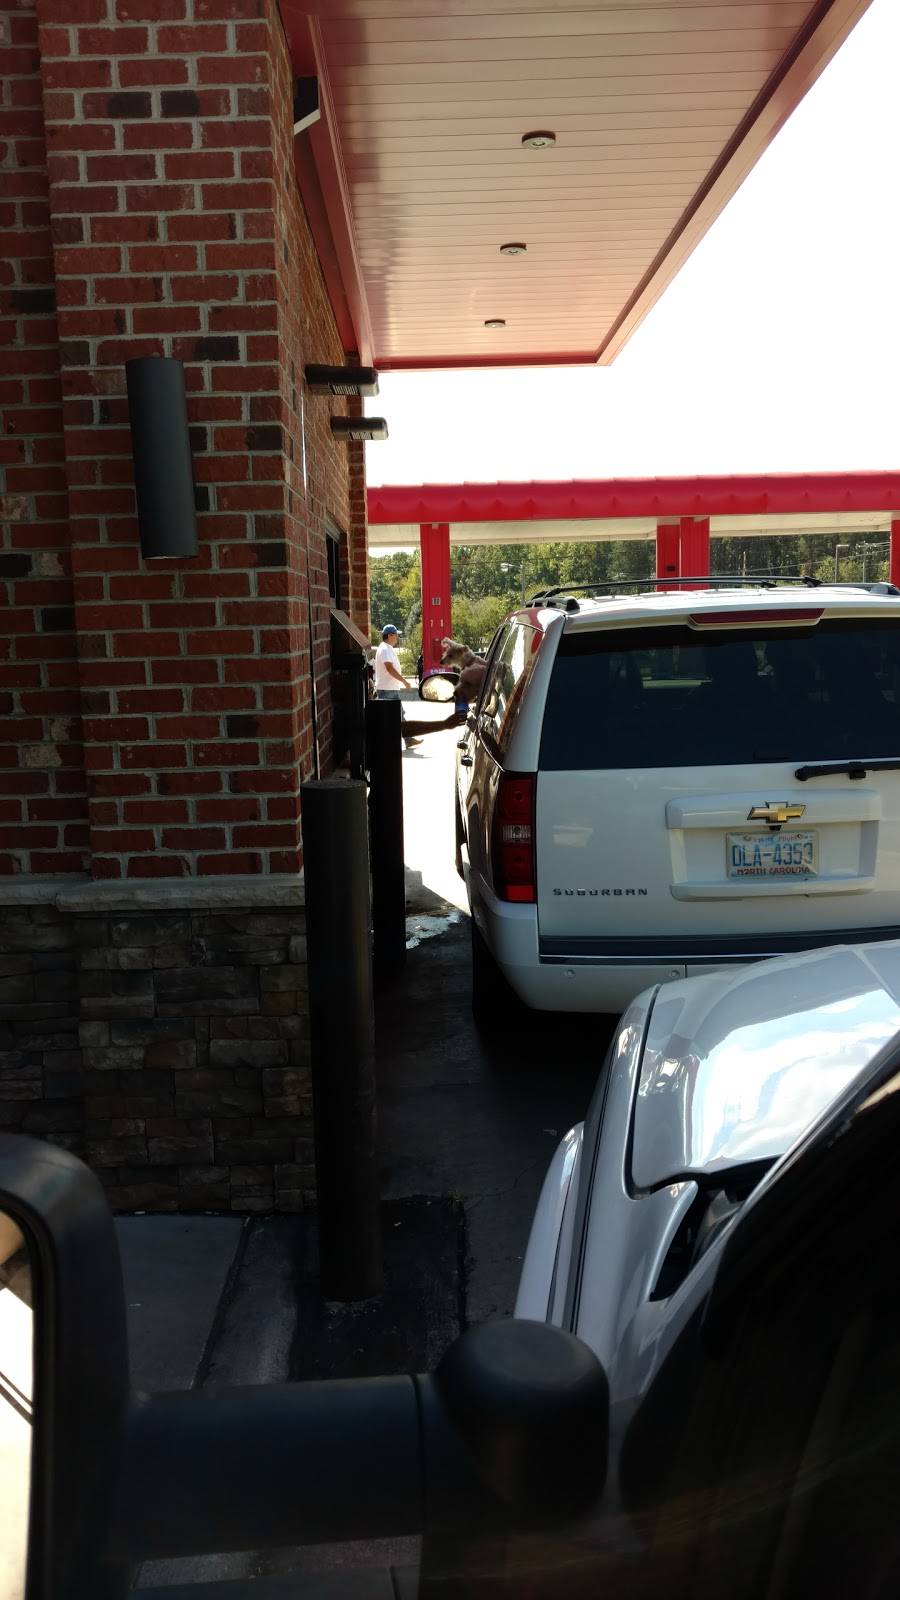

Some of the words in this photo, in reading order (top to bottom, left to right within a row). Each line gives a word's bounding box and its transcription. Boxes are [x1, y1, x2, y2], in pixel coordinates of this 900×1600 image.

[736, 867, 766, 876] NORTH
[769, 866, 810, 875] CAROLINA
[552, 888, 648, 896] SUBURBAN
